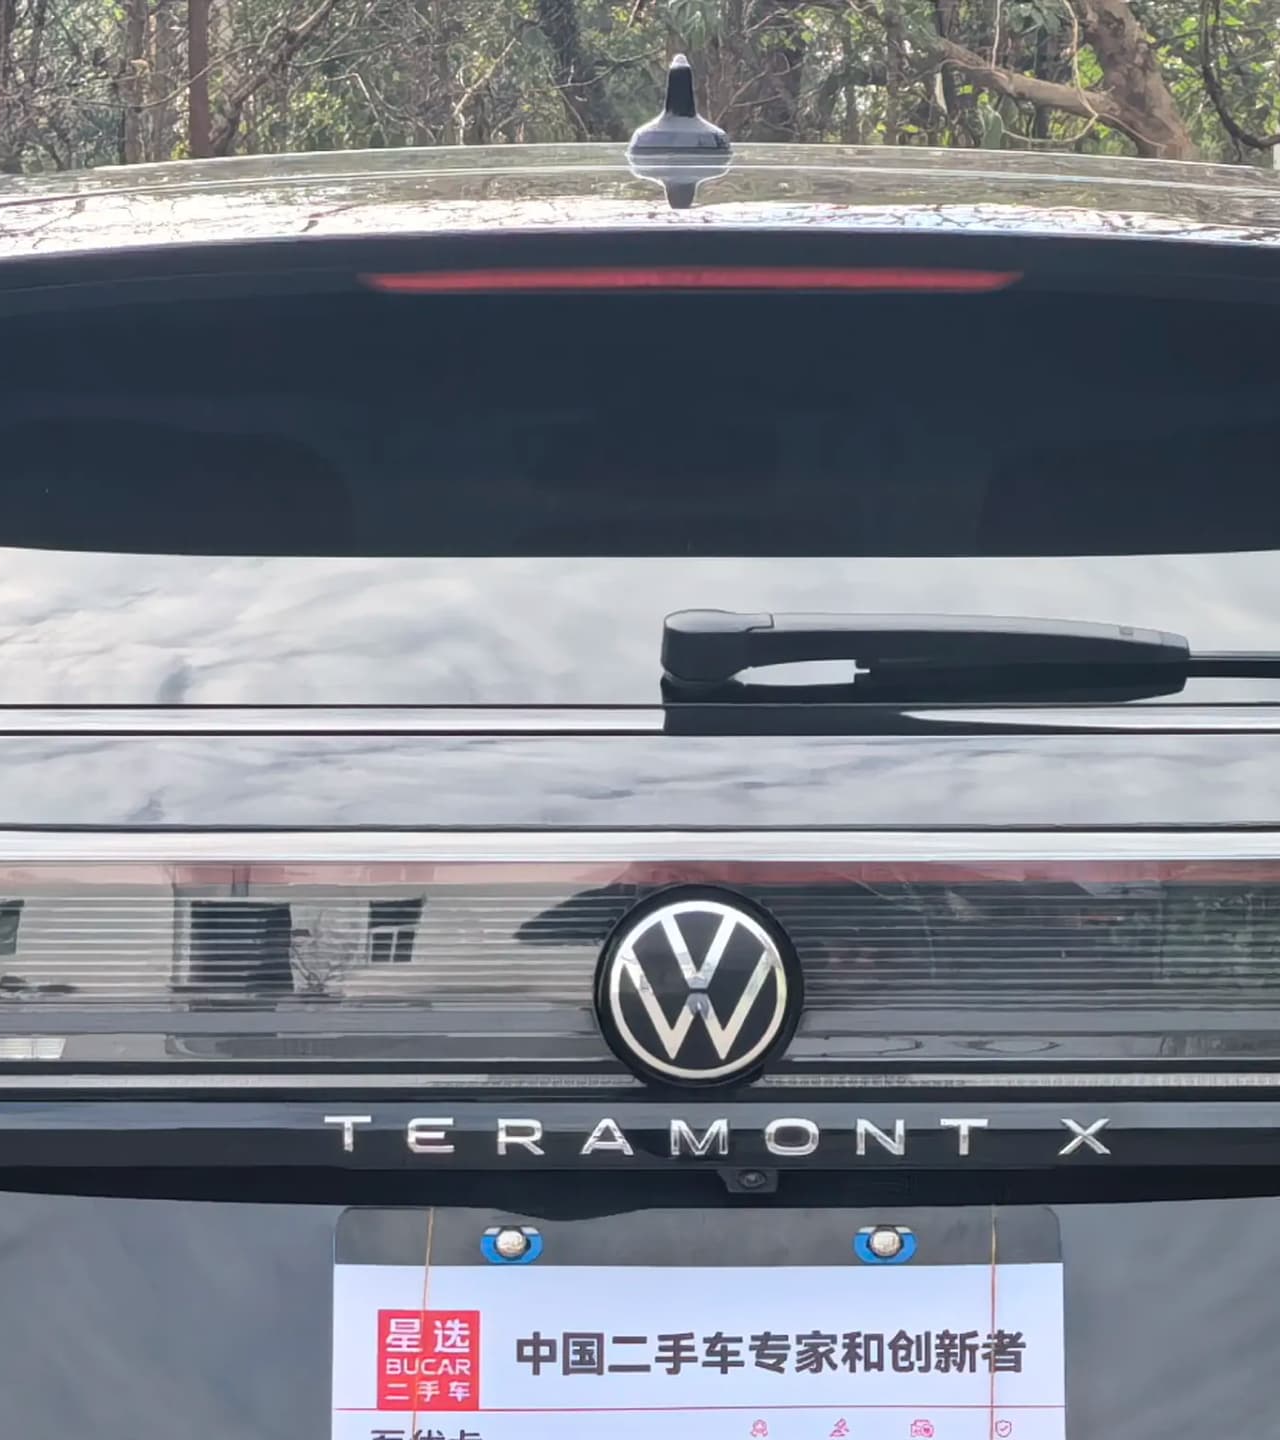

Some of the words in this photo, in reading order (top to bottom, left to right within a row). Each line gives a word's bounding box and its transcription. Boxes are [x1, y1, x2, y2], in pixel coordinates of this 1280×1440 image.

[324, 1114, 988, 1157] TERAMONT
[1057, 1116, 1112, 1156] X
[385, 1318, 471, 1354] 星选
[515, 1328, 1027, 1376] 中国二手车专家和创新者
[385, 1358, 471, 1375] BUCAR
[384, 1380, 471, 1402] 二手车
